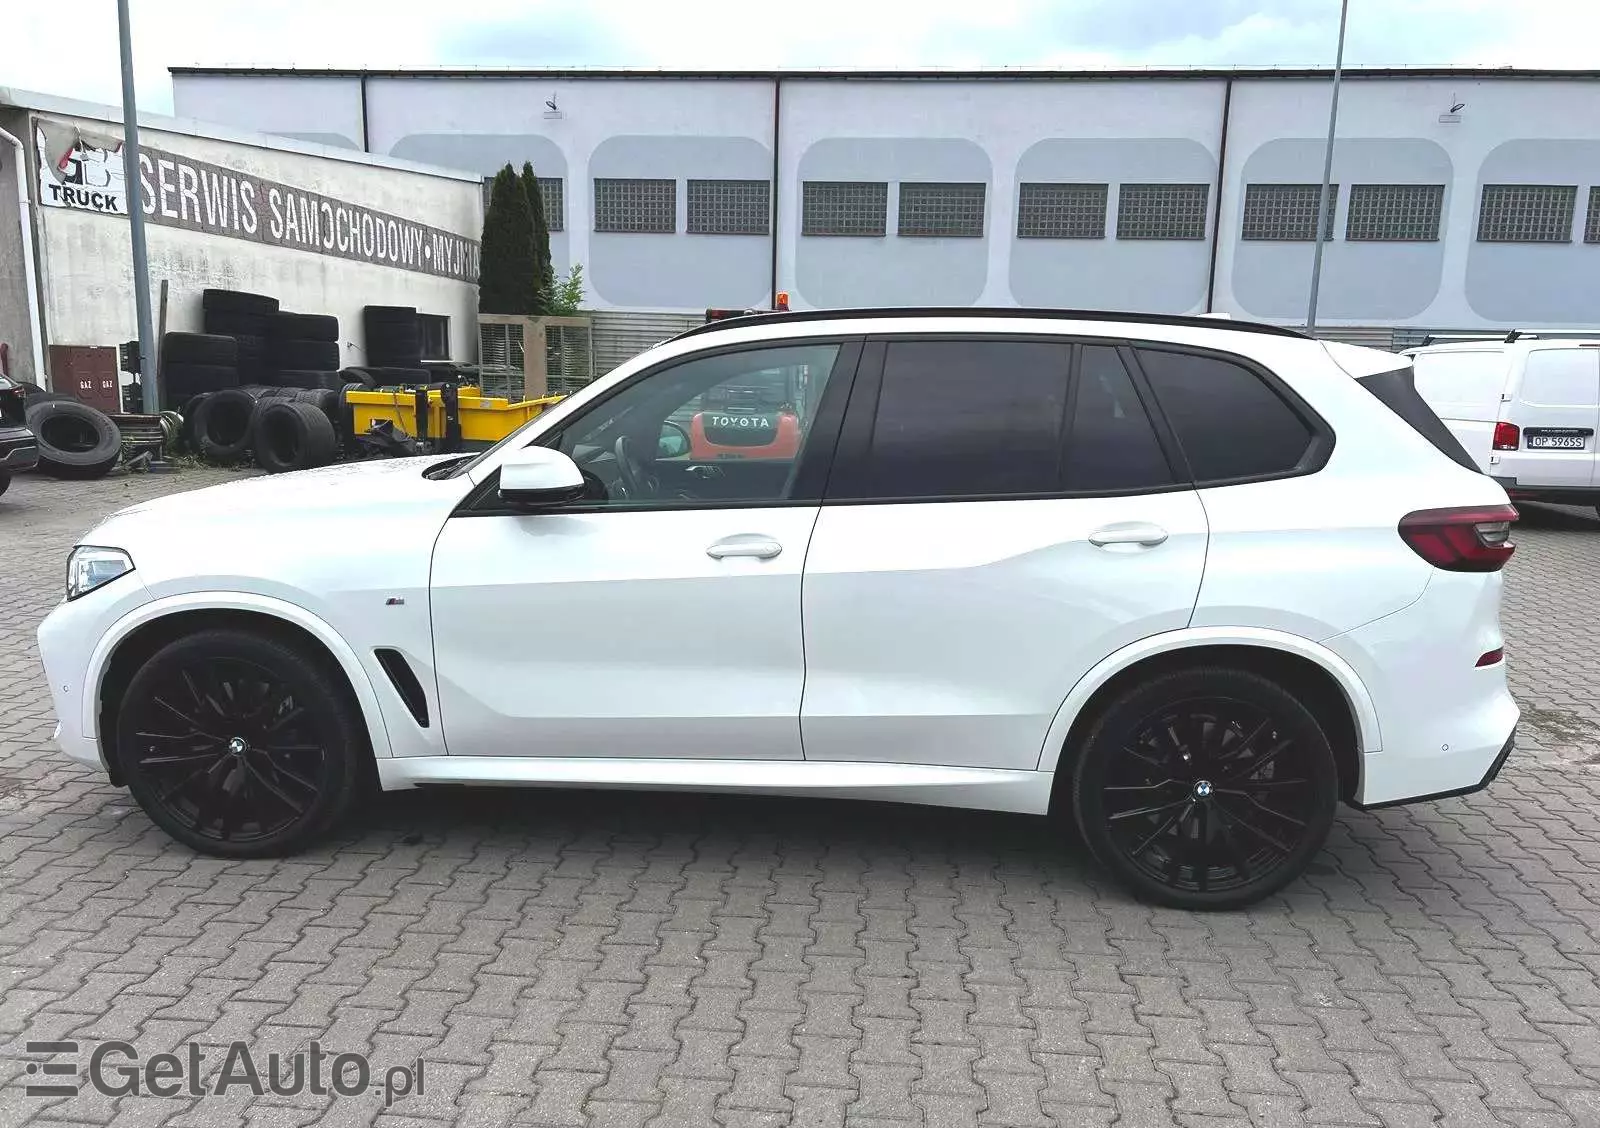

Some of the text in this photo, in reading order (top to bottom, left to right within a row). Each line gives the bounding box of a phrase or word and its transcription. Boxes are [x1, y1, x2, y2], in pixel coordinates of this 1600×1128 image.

[48, 183, 118, 211] TRUCK
[139, 153, 257, 233] SERWIS
[80, 380, 92, 389] GAZ
[102, 380, 113, 388] GAZ
[712, 416, 769, 427] TOYOTA
[1535, 437, 1548, 446] OP
